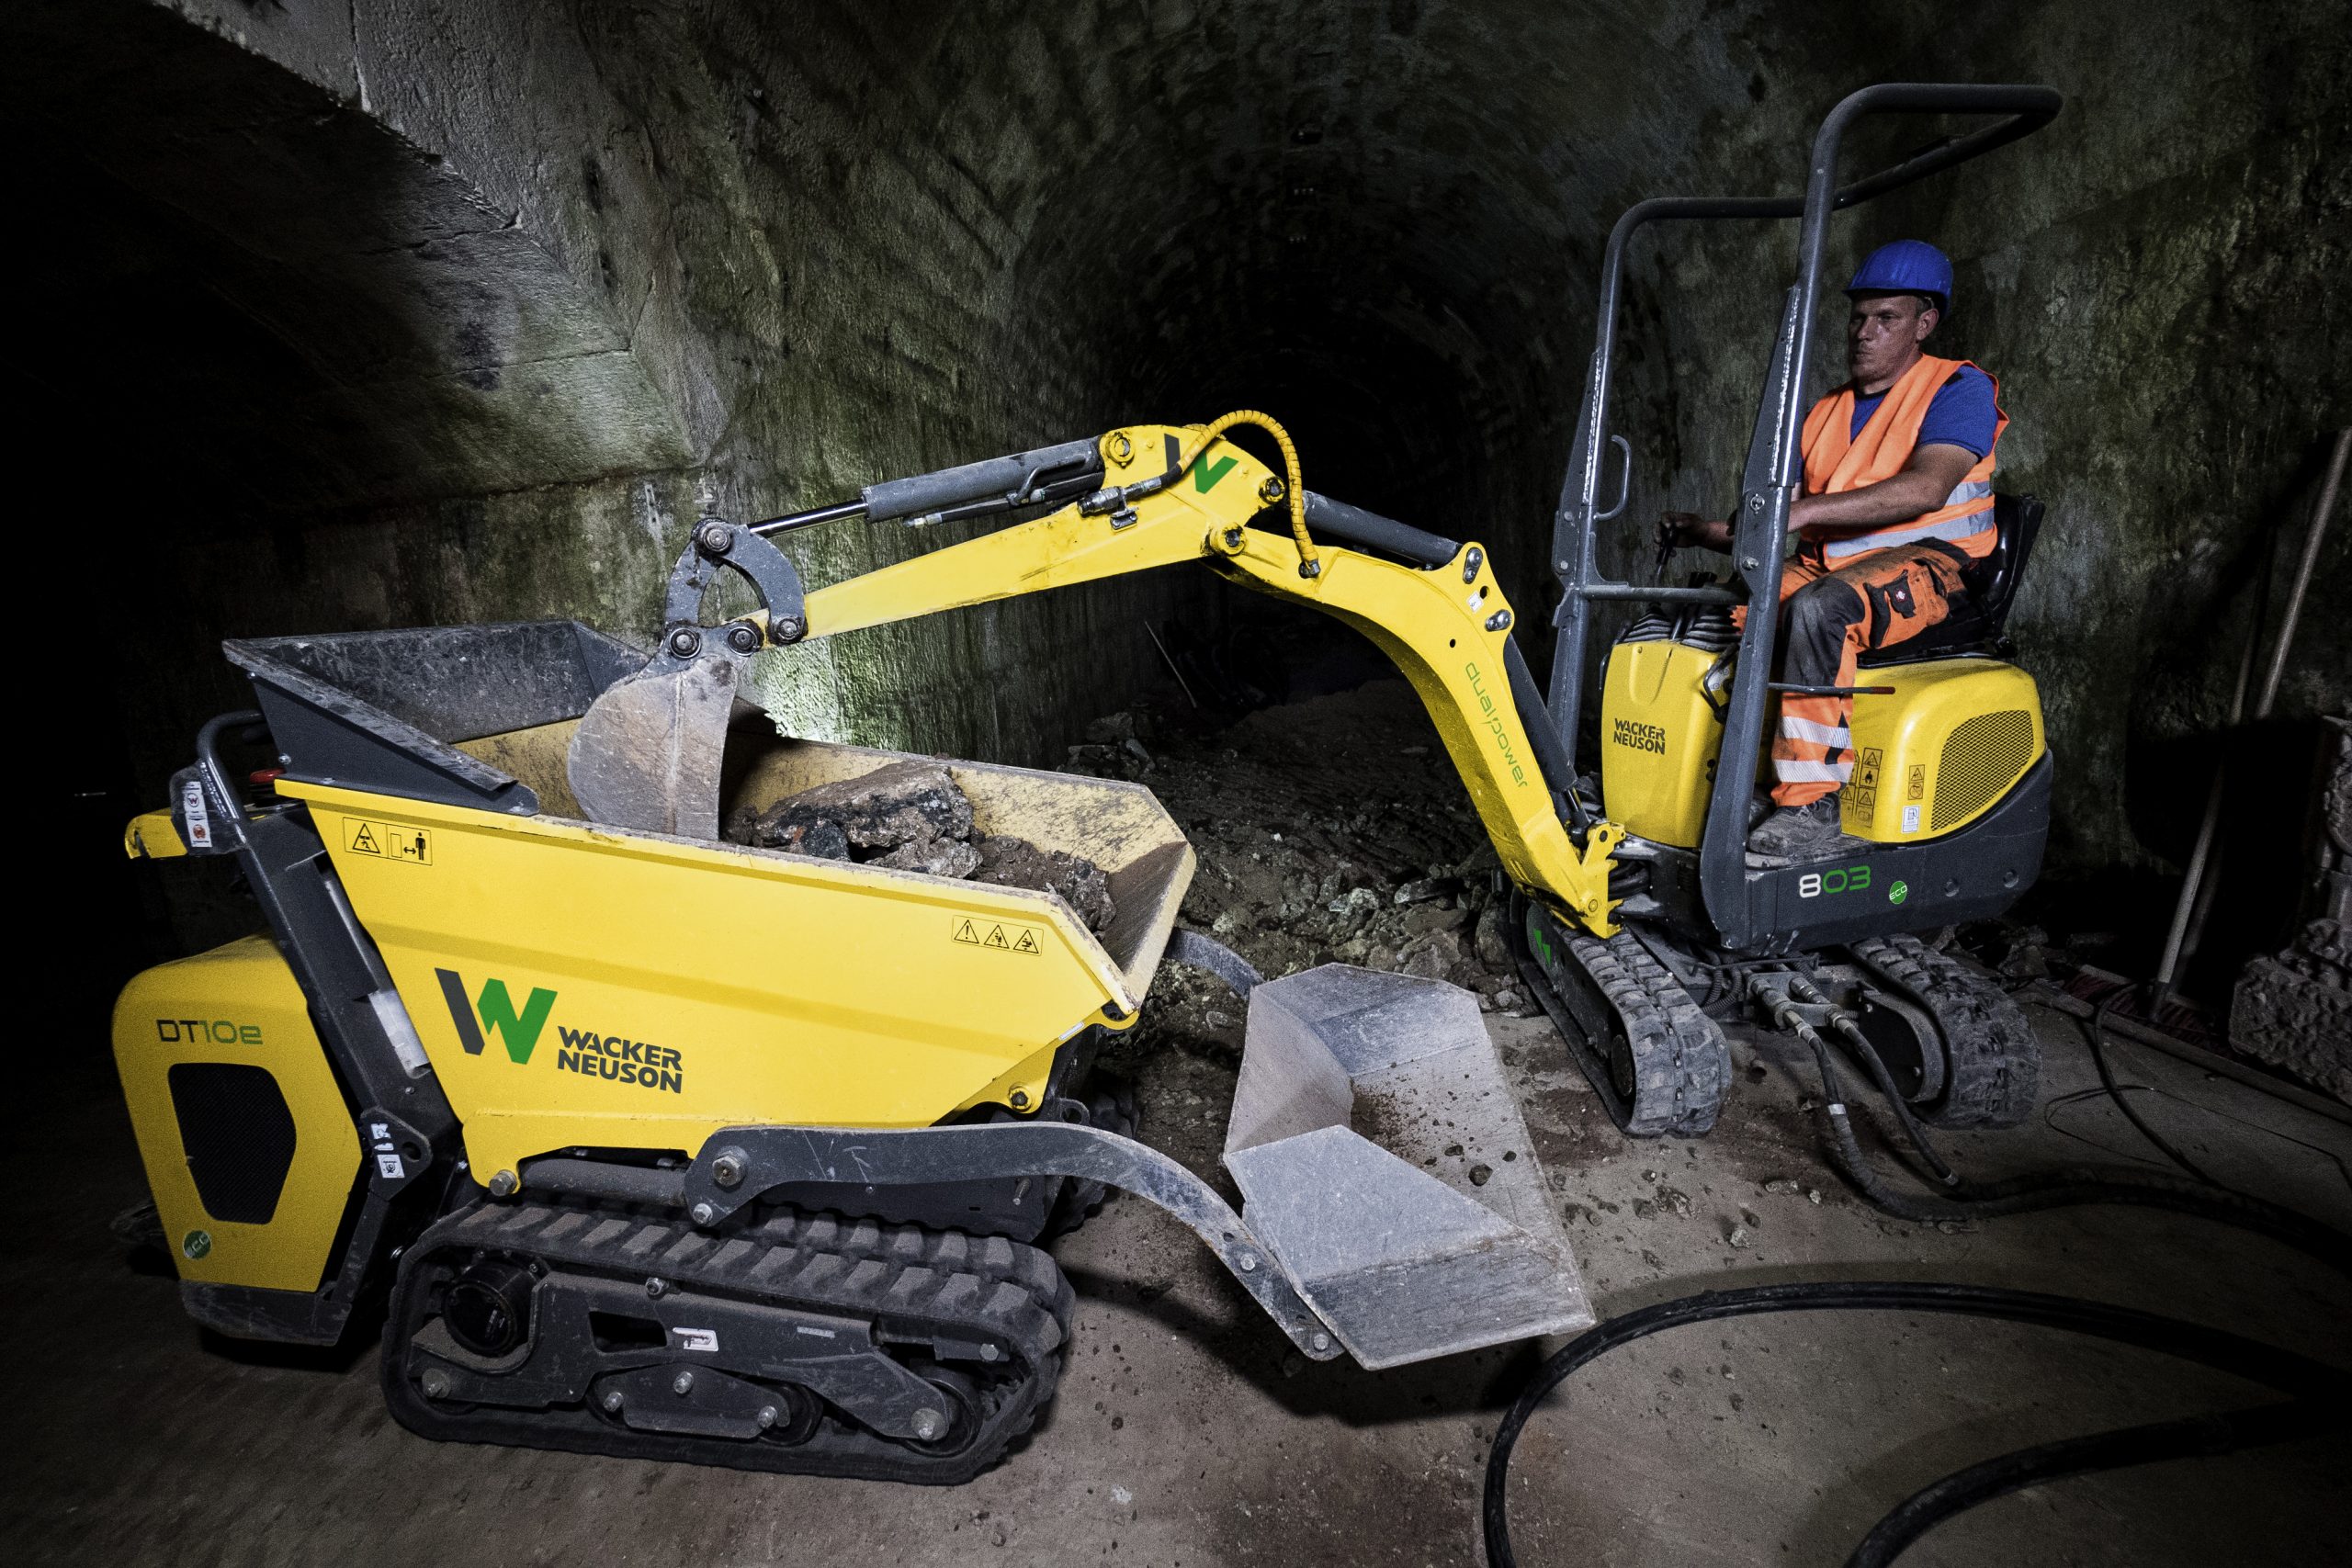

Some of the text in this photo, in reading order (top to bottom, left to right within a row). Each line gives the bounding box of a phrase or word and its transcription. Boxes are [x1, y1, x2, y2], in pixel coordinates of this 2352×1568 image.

[1614, 717, 1666, 741] WACKER
[1613, 730, 1666, 755] NEUSON
[1799, 865, 1871, 898] 803
[1888, 885, 1908, 901] ECO
[156, 1019, 264, 1045] DT10e
[557, 1025, 684, 1072] WACKER
[557, 1048, 683, 1094] NEUSON
